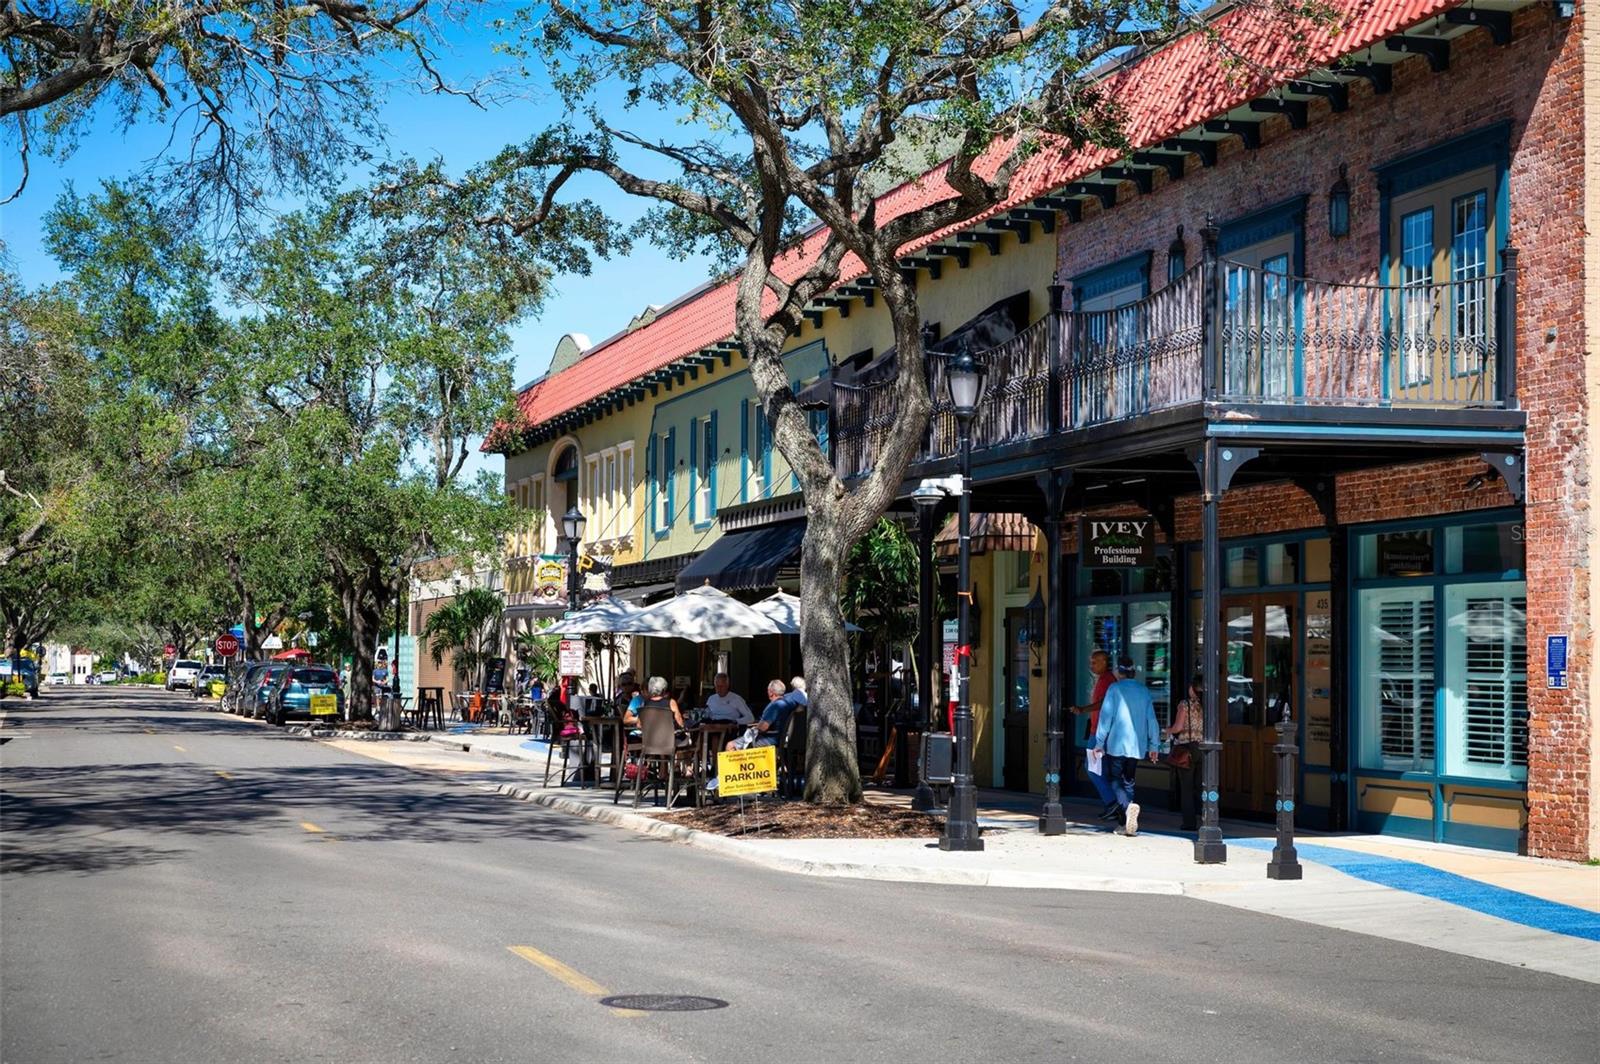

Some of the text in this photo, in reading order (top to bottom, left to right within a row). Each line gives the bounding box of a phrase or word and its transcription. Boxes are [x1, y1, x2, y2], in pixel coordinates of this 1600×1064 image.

[1090, 521, 1148, 541] IVEY
[1094, 546, 1142, 555] Professional
[1102, 555, 1137, 565] Building
[217, 640, 238, 649] STOP
[740, 763, 755, 771] NO
[725, 770, 771, 783] PARKING
